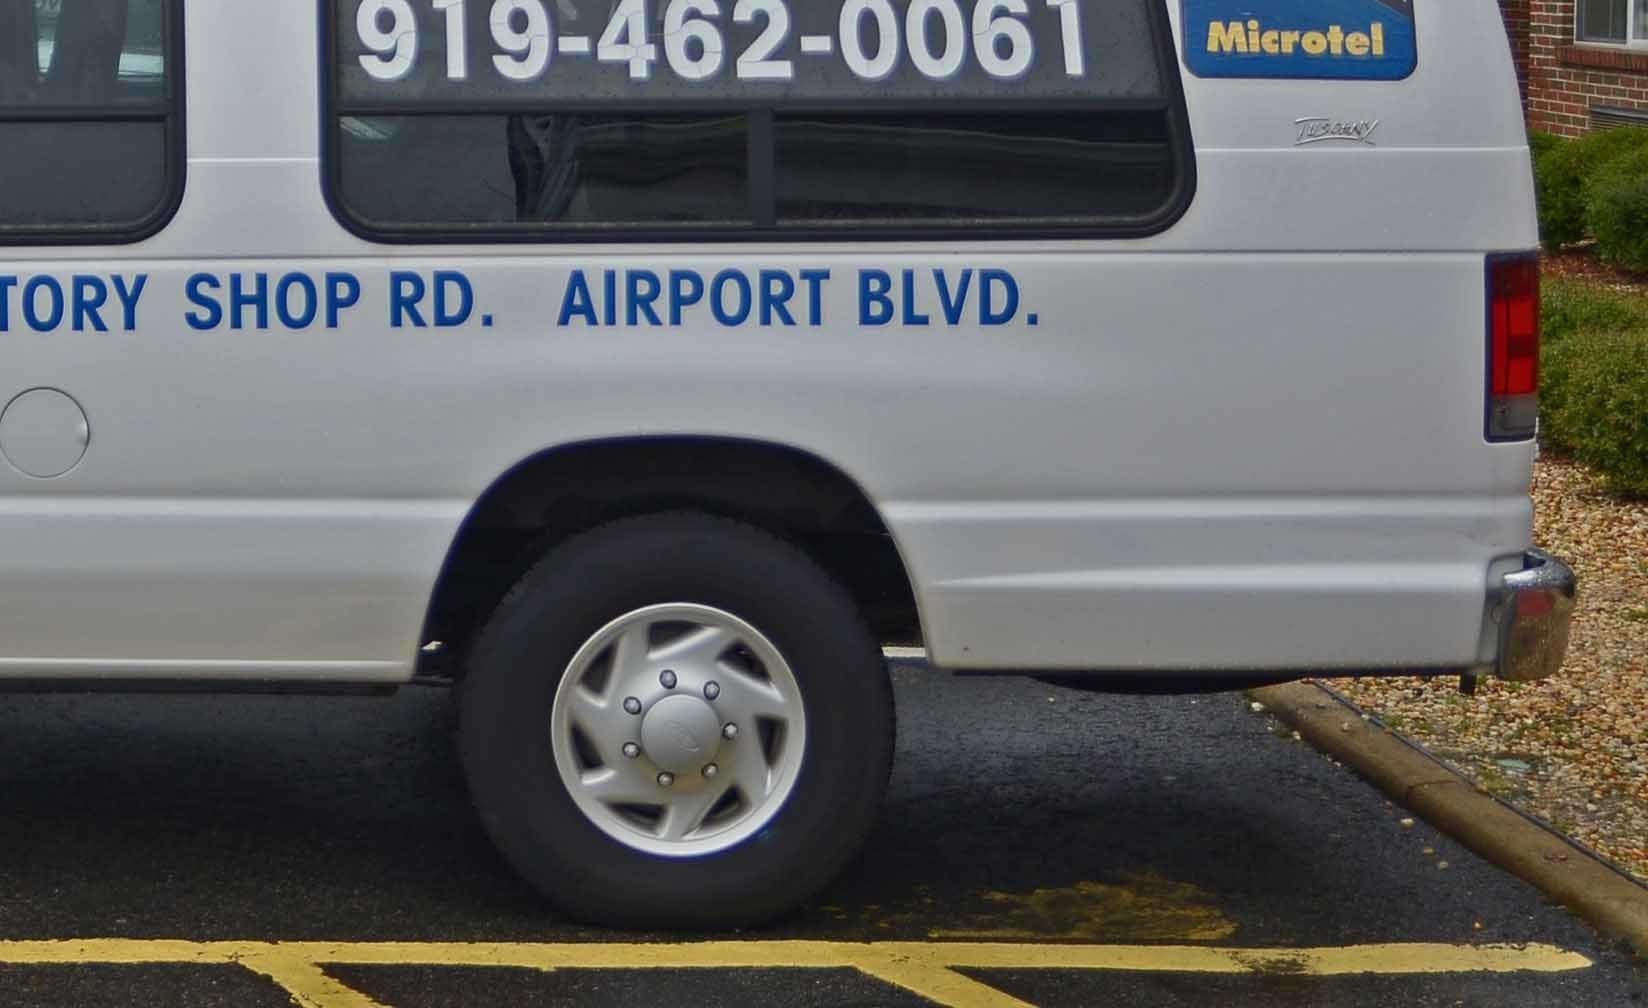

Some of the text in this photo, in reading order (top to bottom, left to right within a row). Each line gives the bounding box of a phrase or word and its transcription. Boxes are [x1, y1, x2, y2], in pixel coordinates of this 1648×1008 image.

[1206, 19, 1385, 57] Microtel
[185, 271, 362, 331] SHOP
[390, 270, 495, 329] RD.
[557, 268, 832, 328] AIRPORT
[858, 268, 1040, 327] BLVD.
